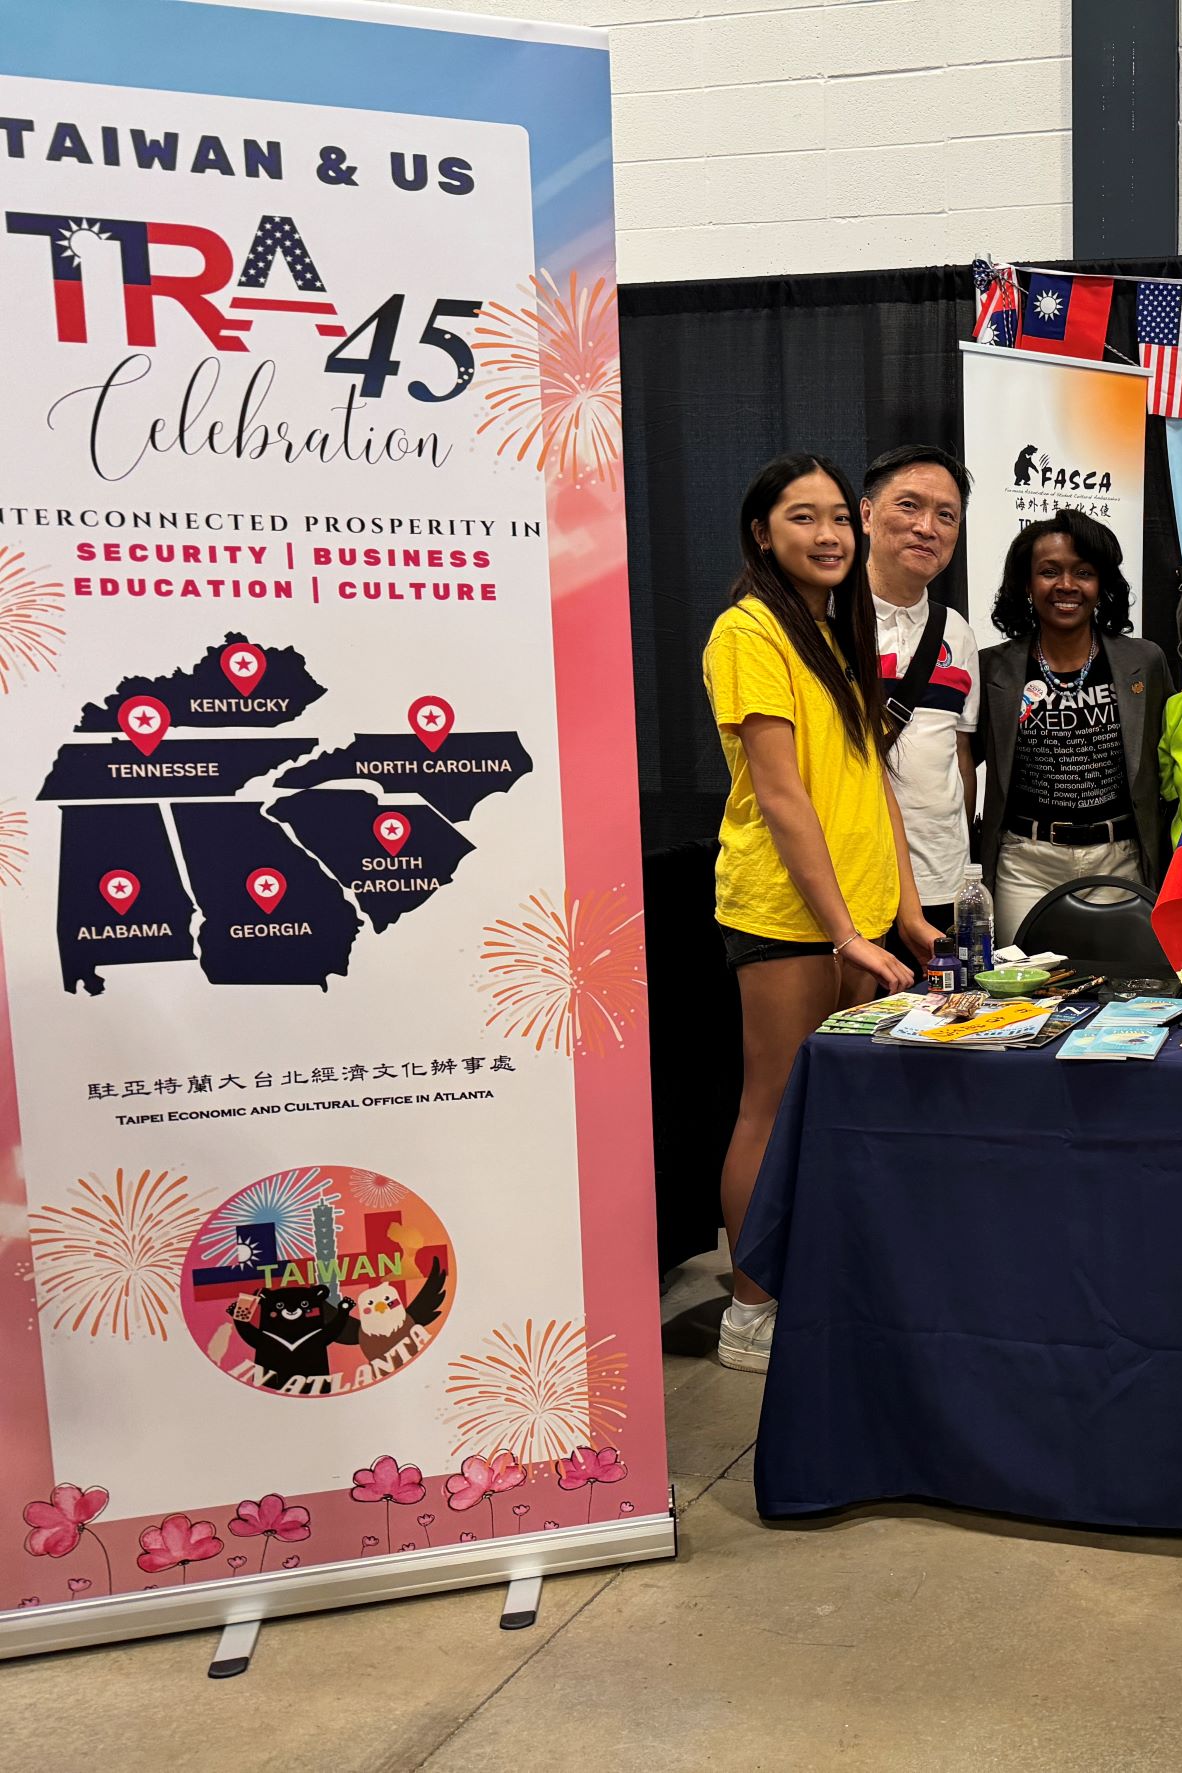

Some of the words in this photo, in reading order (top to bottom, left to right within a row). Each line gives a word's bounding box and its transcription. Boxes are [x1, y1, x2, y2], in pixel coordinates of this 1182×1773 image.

[0, 116, 284, 181] TAIWAN
[316, 145, 359, 187] &
[390, 151, 476, 196] US
[5, 210, 348, 353] TRA
[324, 293, 484, 403] 45
[47, 352, 453, 482] Celebration
[1040, 466, 1112, 494] FASCA
[0, 507, 289, 532] TERCONNECTED
[304, 515, 497, 537] PROSPERITY
[511, 520, 542, 538] IN
[75, 542, 268, 565] SECURITY
[313, 547, 491, 569] BUSINESS
[73, 577, 293, 599] EDUCATION
[338, 581, 497, 601] CULTURE
[189, 698, 290, 714] KENTUCKY
[1054, 746, 1075, 754] black
[107, 762, 220, 778] TENNESSEE
[355, 760, 419, 775] NORTH
[422, 758, 513, 774] CAROLINA
[1052, 799, 1077, 808] mainly
[361, 856, 423, 871] SOUTH
[351, 877, 441, 894] CAROLINA
[77, 923, 172, 941] ALABAMA
[229, 922, 312, 939] GEORGIA
[87, 1054, 517, 1101] 駐亞特蘭大台北經濟文化辦事處
[115, 1113, 164, 1126] TAIPEI
[167, 1107, 247, 1122] ECONOMIC
[284, 1099, 359, 1112] CULTURAL
[362, 1094, 413, 1107] OFFICE
[433, 1089, 494, 1102] ATLANTA
[256, 1252, 403, 1289] TAIWAN
[227, 1358, 278, 1388] IN
[279, 1323, 433, 1396] ATLANTA
